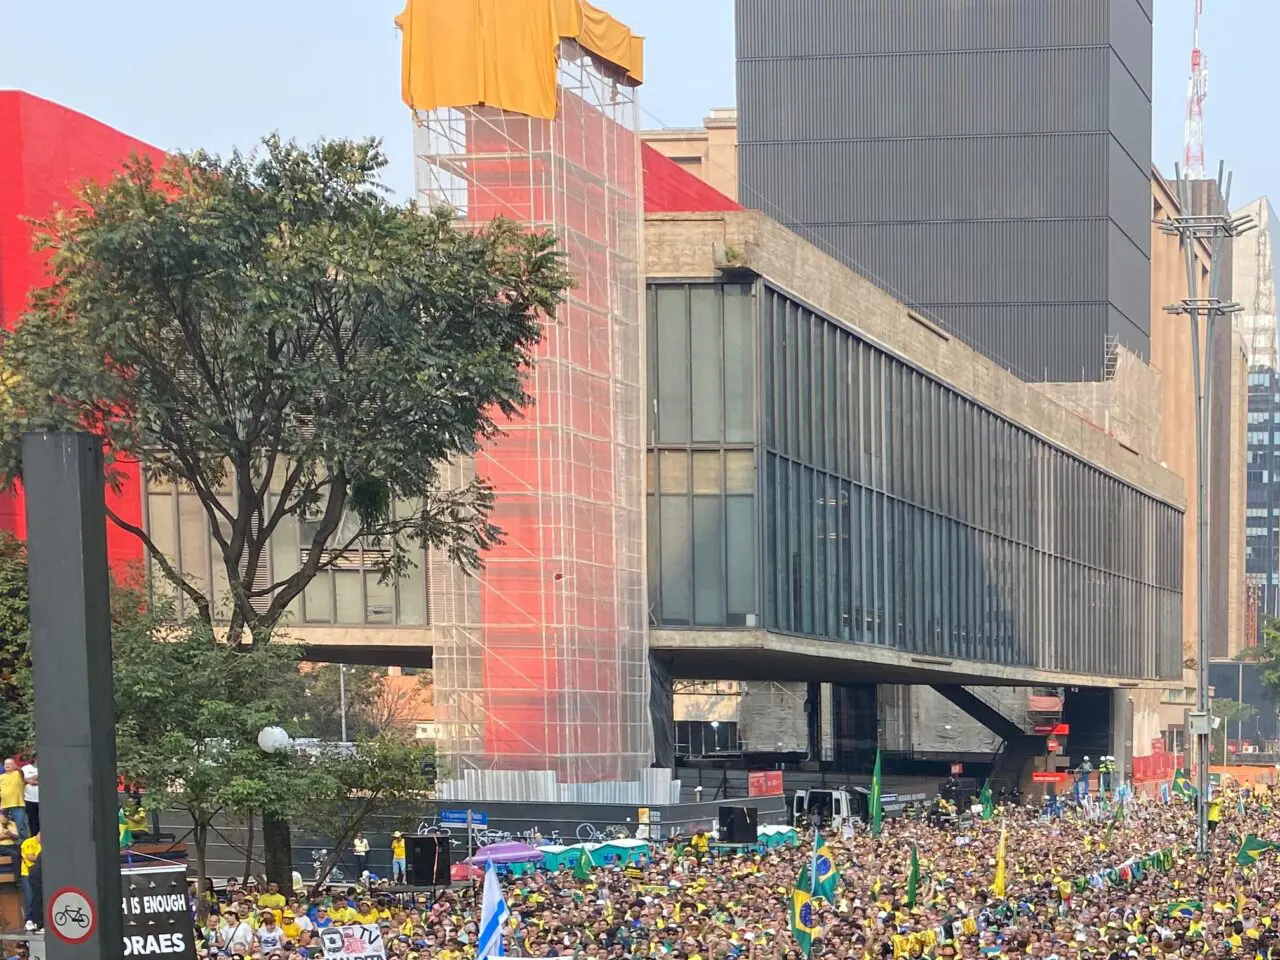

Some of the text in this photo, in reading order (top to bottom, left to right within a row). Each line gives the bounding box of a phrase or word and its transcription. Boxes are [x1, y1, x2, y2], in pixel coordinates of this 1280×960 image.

[131, 897, 141, 915] IS
[144, 894, 187, 914] ENOUGH
[123, 933, 185, 956] ORAES
[360, 926, 380, 945] TV
